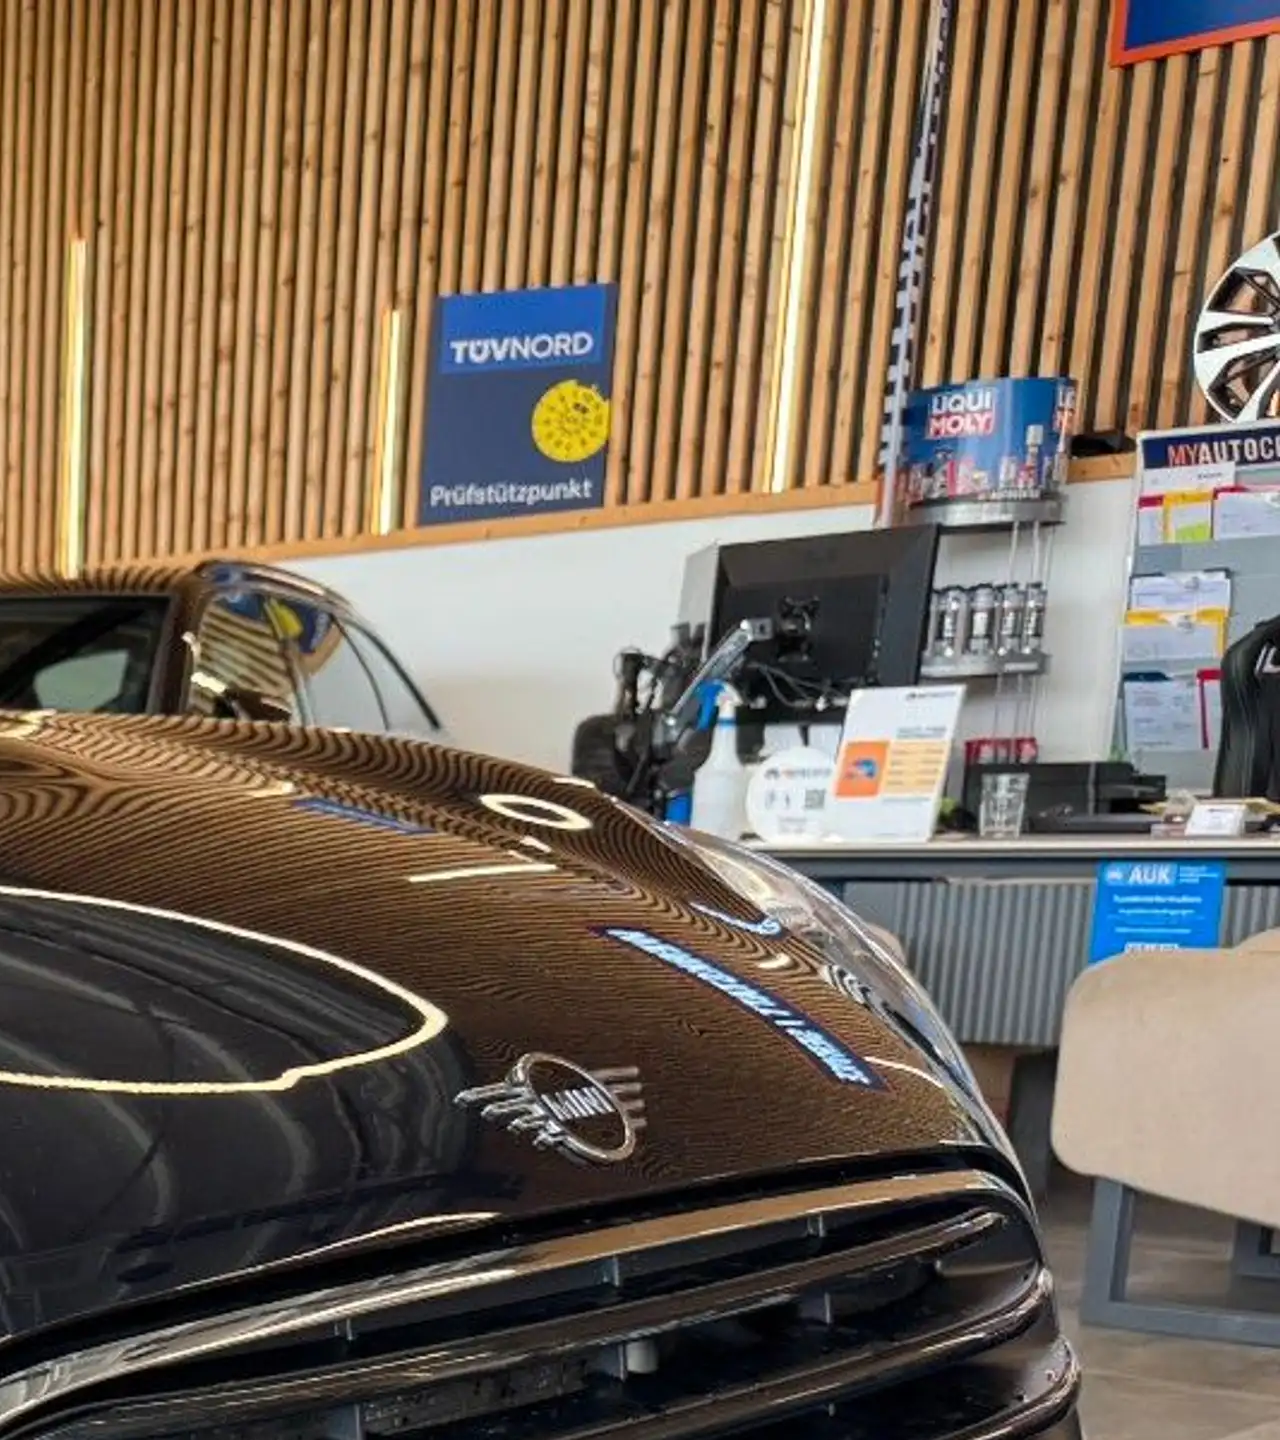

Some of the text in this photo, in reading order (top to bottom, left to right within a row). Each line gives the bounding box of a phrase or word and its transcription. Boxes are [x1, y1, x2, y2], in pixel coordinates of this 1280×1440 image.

[932, 387, 991, 413] LIQUI
[929, 411, 993, 438] MOLY
[1167, 434, 1280, 467] MYAUTOC
[430, 477, 592, 507] Prüfstützpunkt
[1128, 863, 1171, 884] AUK
